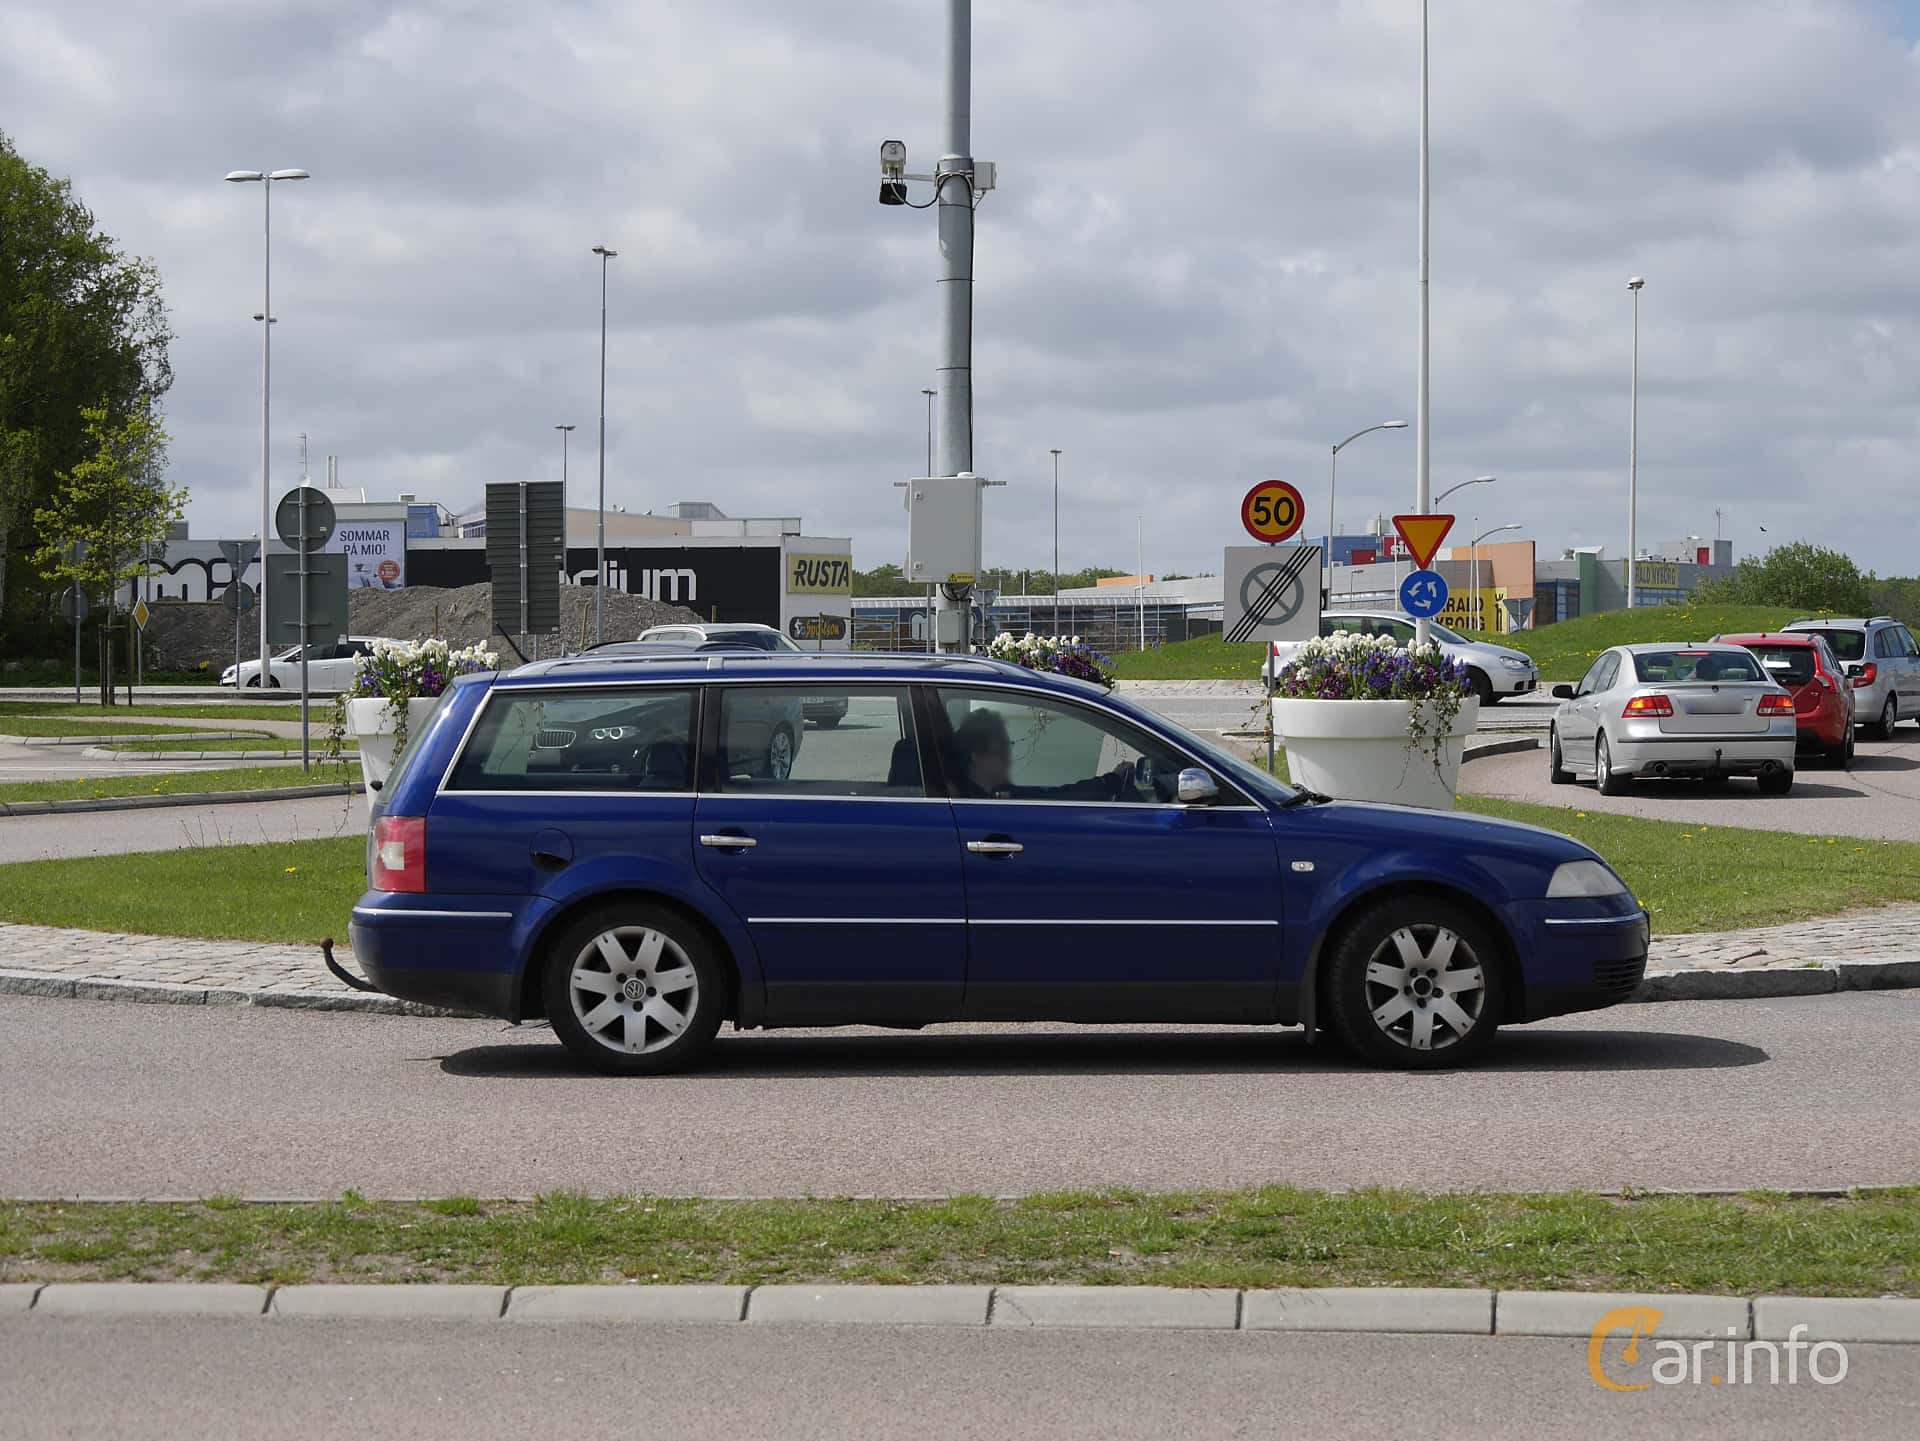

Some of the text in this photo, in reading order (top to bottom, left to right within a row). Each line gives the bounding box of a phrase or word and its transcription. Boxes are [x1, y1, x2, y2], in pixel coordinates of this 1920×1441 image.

[1253, 496, 1295, 526] 50
[339, 530, 390, 541] SOMMAR
[344, 543, 386, 555] PÅ MIO!
[794, 559, 849, 588] RUSTA
[1442, 597, 1484, 612] RALD
